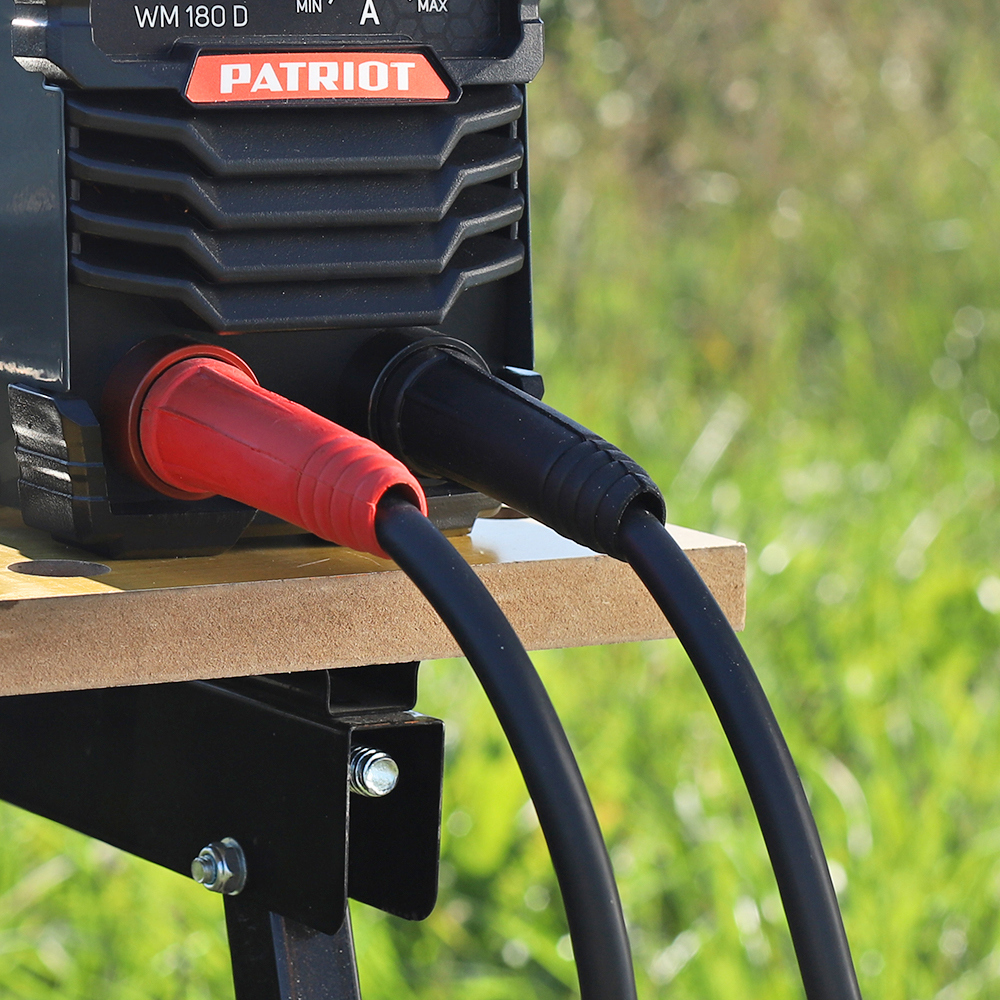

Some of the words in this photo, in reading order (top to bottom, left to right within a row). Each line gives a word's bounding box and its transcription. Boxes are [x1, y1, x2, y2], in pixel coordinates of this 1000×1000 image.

[134, 5, 179, 28] WM
[185, 4, 226, 28] 180
[232, 5, 249, 28] D
[296, 0, 323, 14] MIN
[359, 0, 380, 26] A
[219, 61, 416, 94] PATRIOT
